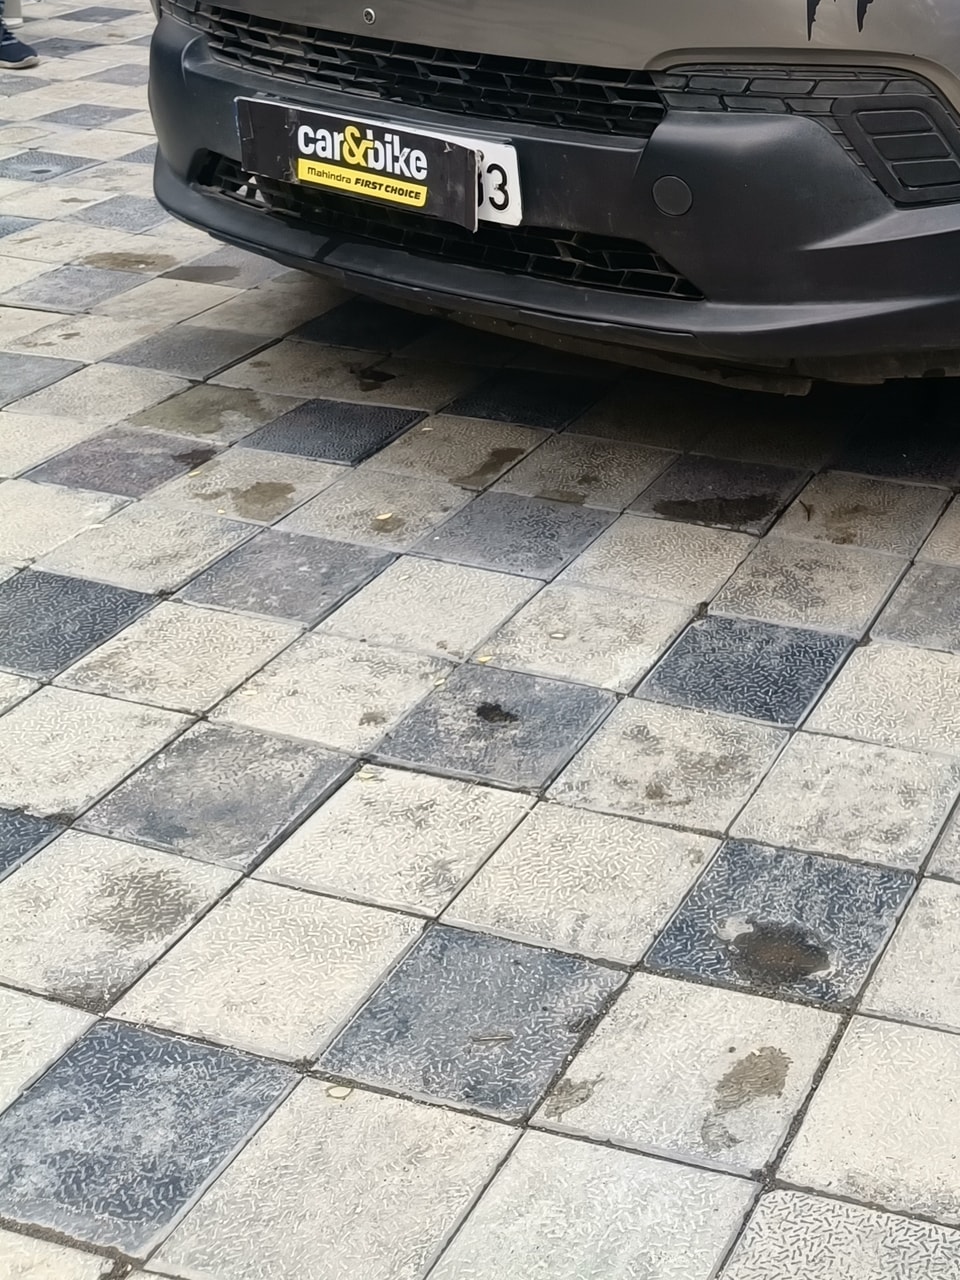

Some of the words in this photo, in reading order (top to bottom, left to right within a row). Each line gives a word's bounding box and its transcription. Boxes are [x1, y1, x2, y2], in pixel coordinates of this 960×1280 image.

[297, 125, 428, 180] car&bike
[354, 177, 384, 192] FIRST
[384, 184, 421, 200] CHOICE
[478, 163, 509, 211] 3
